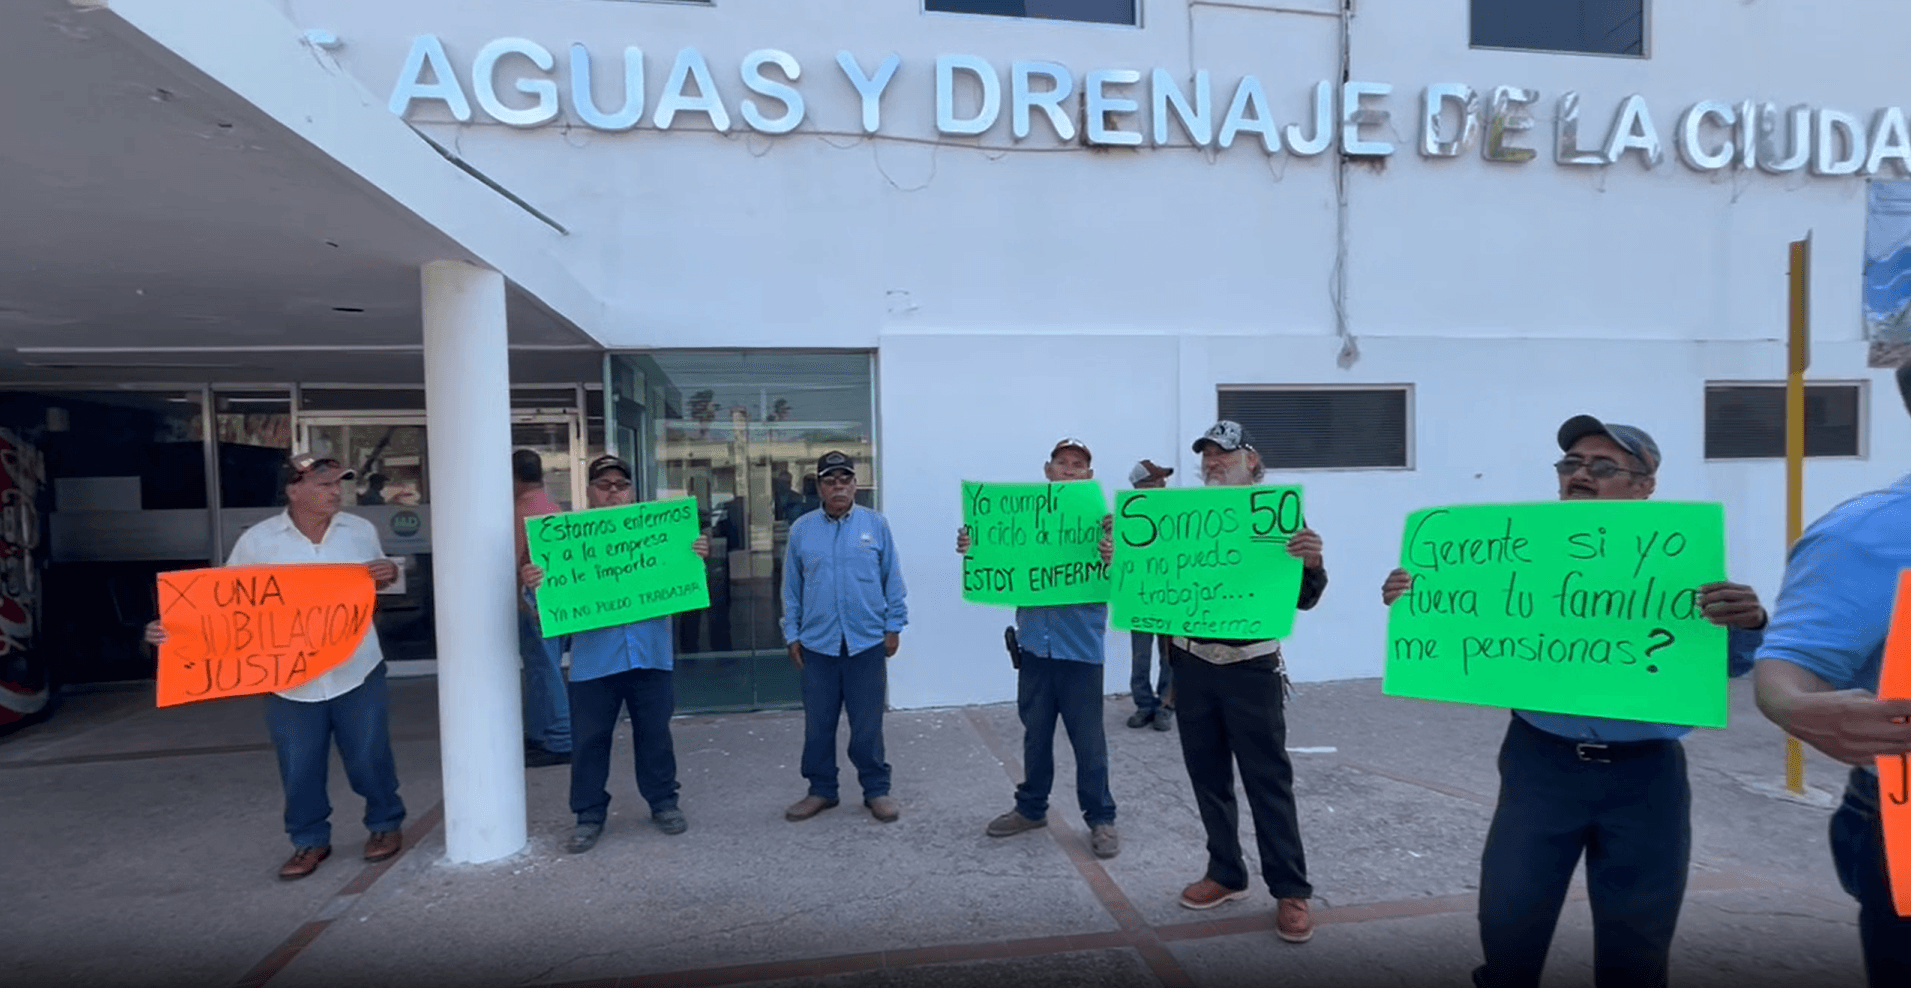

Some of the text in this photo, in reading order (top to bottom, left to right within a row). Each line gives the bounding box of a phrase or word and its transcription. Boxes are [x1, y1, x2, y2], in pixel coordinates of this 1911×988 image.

[389, 33, 806, 134] AGUAS
[836, 49, 902, 134] Y
[935, 54, 1396, 158] DRENAJE
[1420, 84, 1540, 162] DE
[1555, 92, 1663, 168] LA
[538, 505, 692, 543] Estamos enfermos
[965, 484, 1066, 529] Ya cumplí
[1121, 490, 1300, 548] Somos 50
[541, 532, 669, 572] y a la empresa
[988, 516, 1027, 547] ciclo
[1036, 518, 1052, 546] de
[1408, 510, 1686, 578] Gerente si yo
[547, 575, 568, 588] no
[571, 567, 586, 585] le
[963, 555, 1015, 592] ESTOY
[1115, 540, 1242, 593] ya no puedo
[159, 573, 286, 614] X UNA
[549, 581, 702, 624] YA NO PUEDO TRABAJAR
[1402, 571, 1703, 620] fuera tu familia
[200, 603, 370, 657] JUBILACION
[1130, 609, 1262, 634] estoy enfermo
[1394, 627, 1675, 675] me pensionas?
